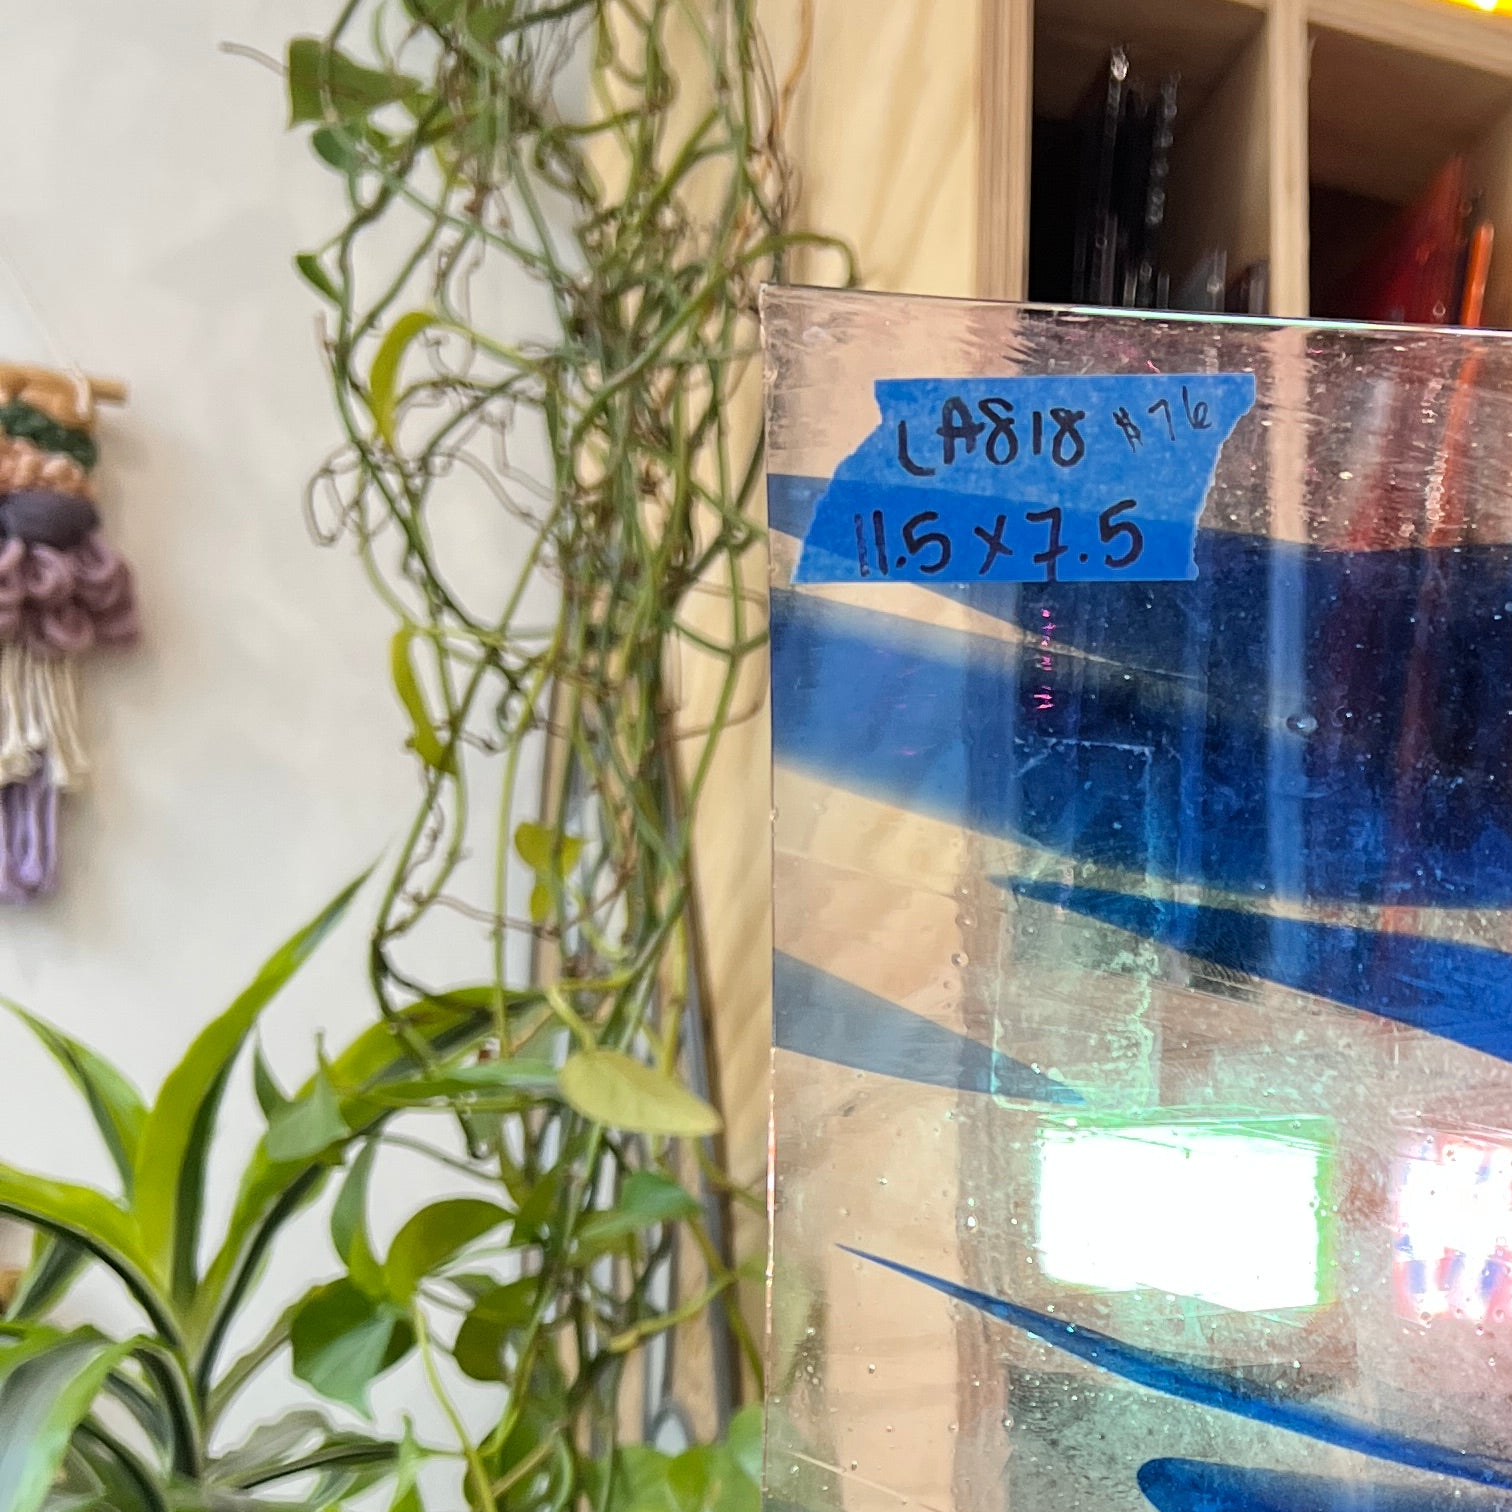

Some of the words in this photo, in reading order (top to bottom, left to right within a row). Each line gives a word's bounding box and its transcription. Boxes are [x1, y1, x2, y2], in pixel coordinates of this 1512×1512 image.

[898, 396, 1086, 477] LA818
[1113, 386, 1213, 453] $76
[854, 505, 952, 577] 11.5
[1026, 499, 1144, 581] 7.5
